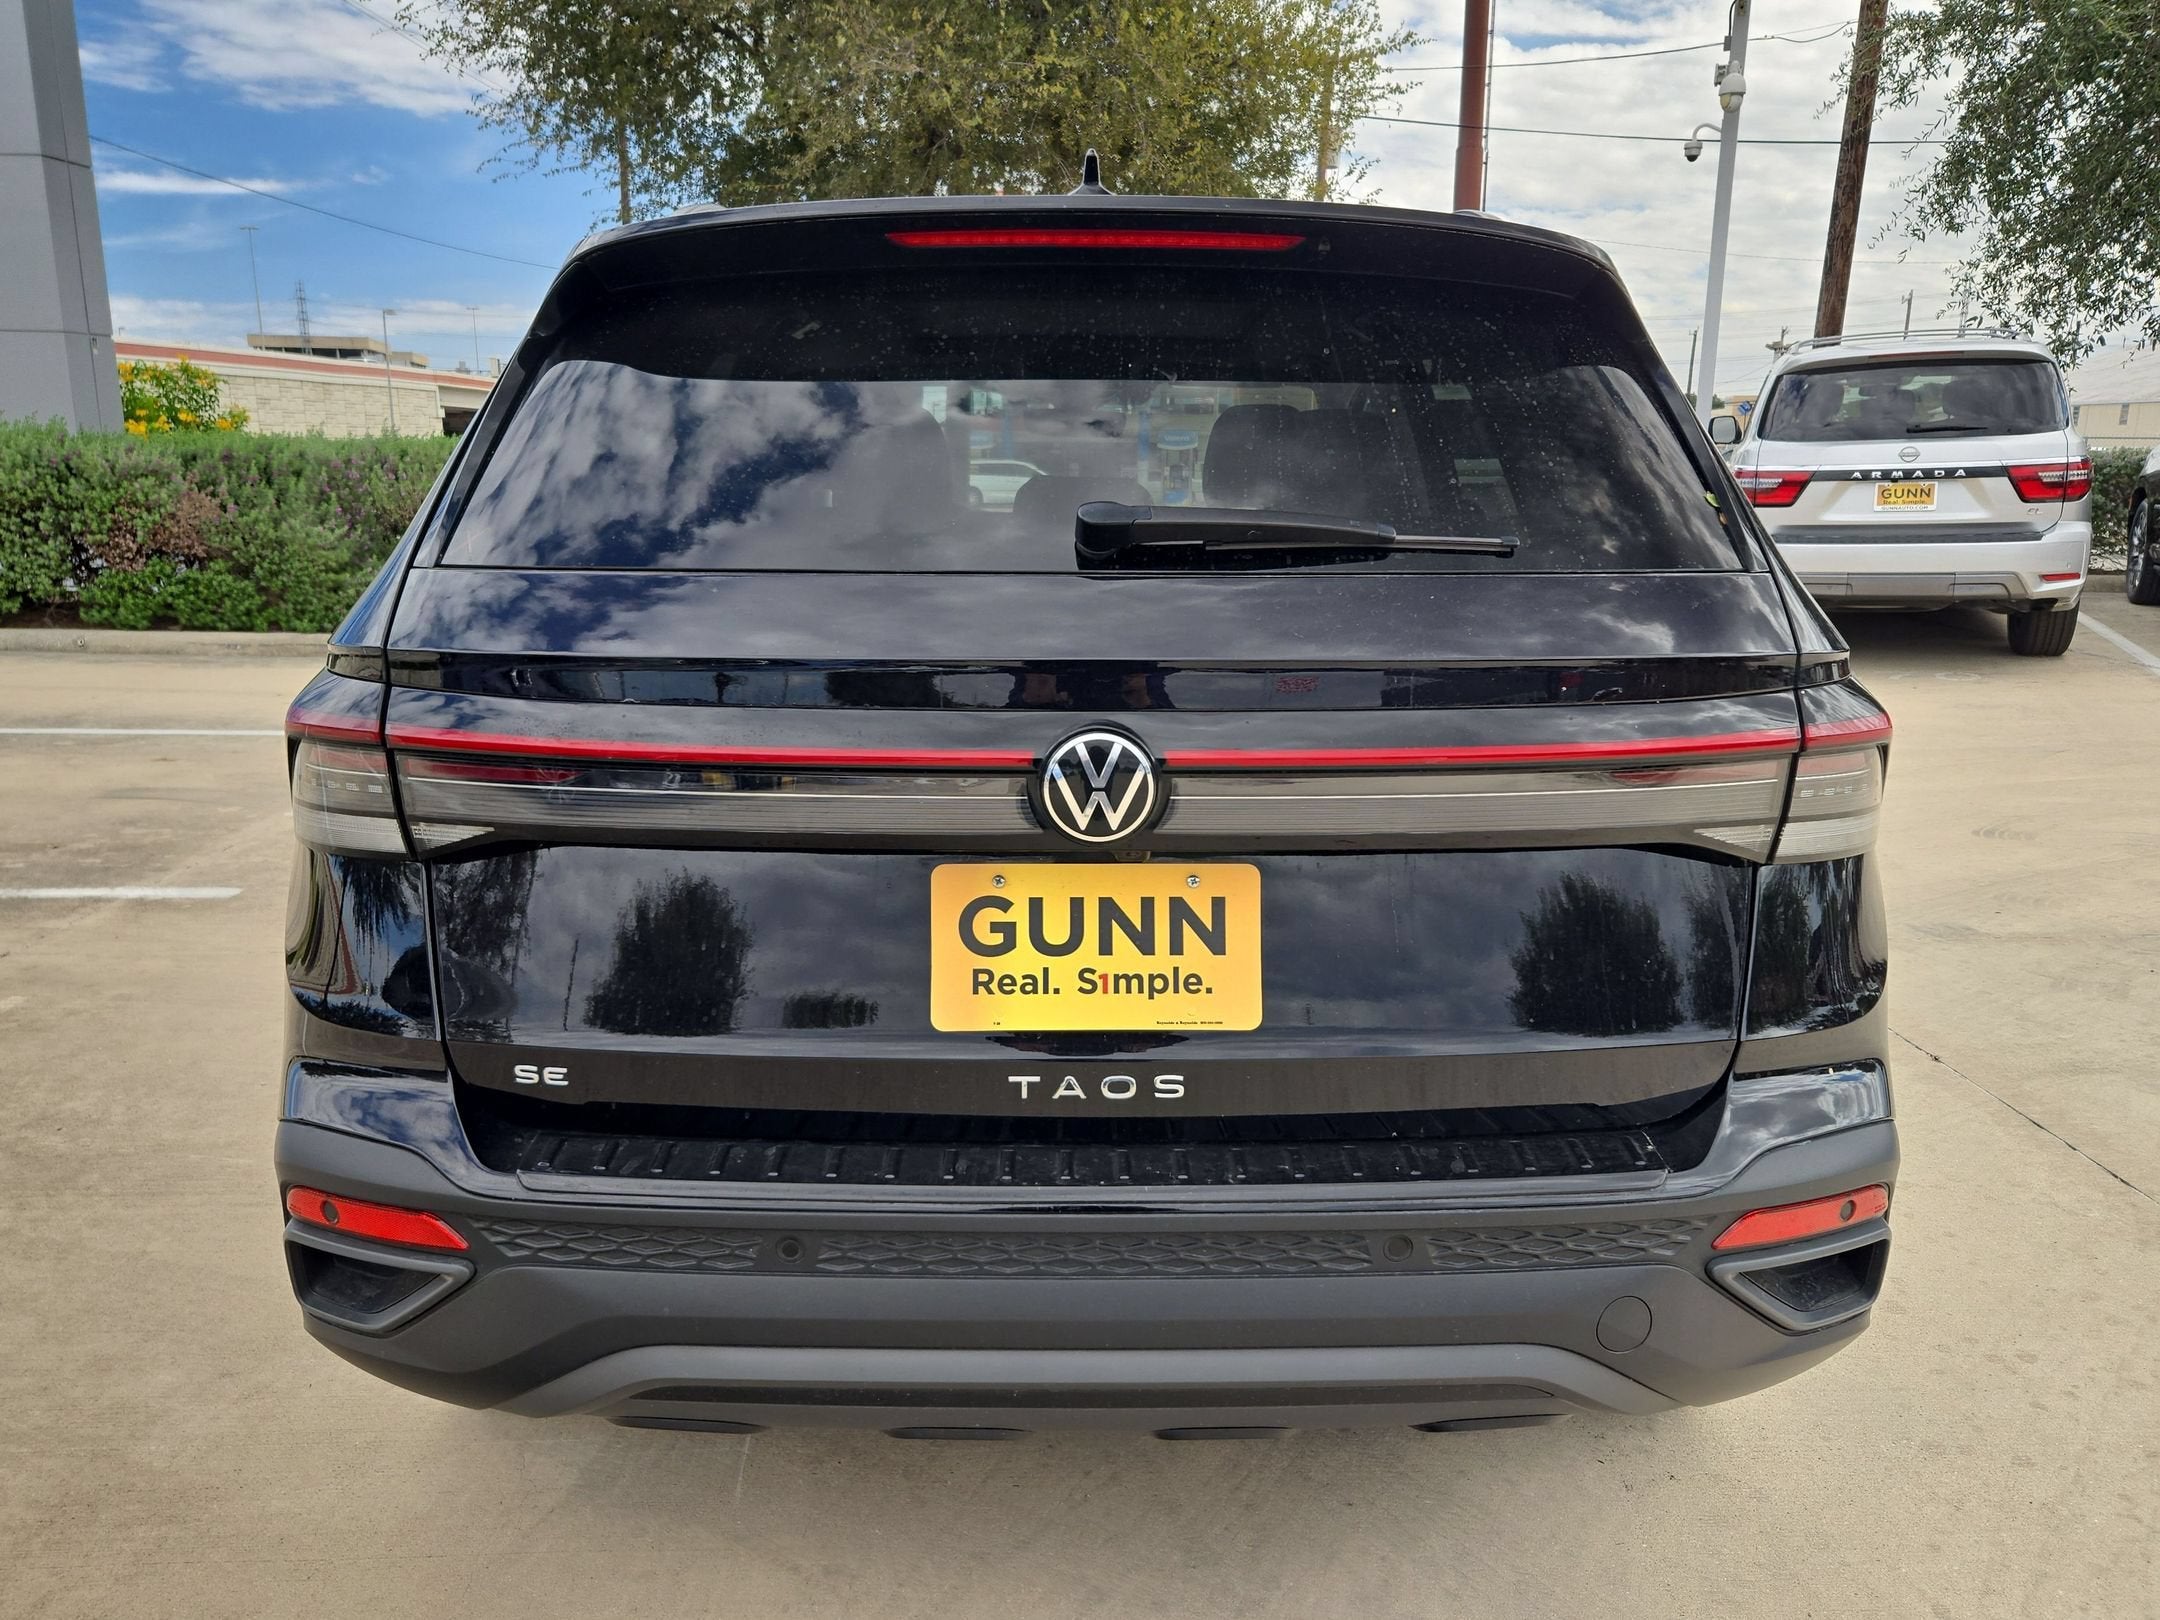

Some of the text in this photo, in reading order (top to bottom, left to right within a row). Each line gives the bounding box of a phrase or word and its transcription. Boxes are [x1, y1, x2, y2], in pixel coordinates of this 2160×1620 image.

[1850, 468, 1966, 479] ARMADA
[1881, 487, 1931, 499] GUNN
[958, 895, 1227, 957] GUNN
[972, 966, 1213, 1000] Real. S1mple.
[514, 1064, 569, 1086] SE
[1008, 1075, 1185, 1099] TAOS
